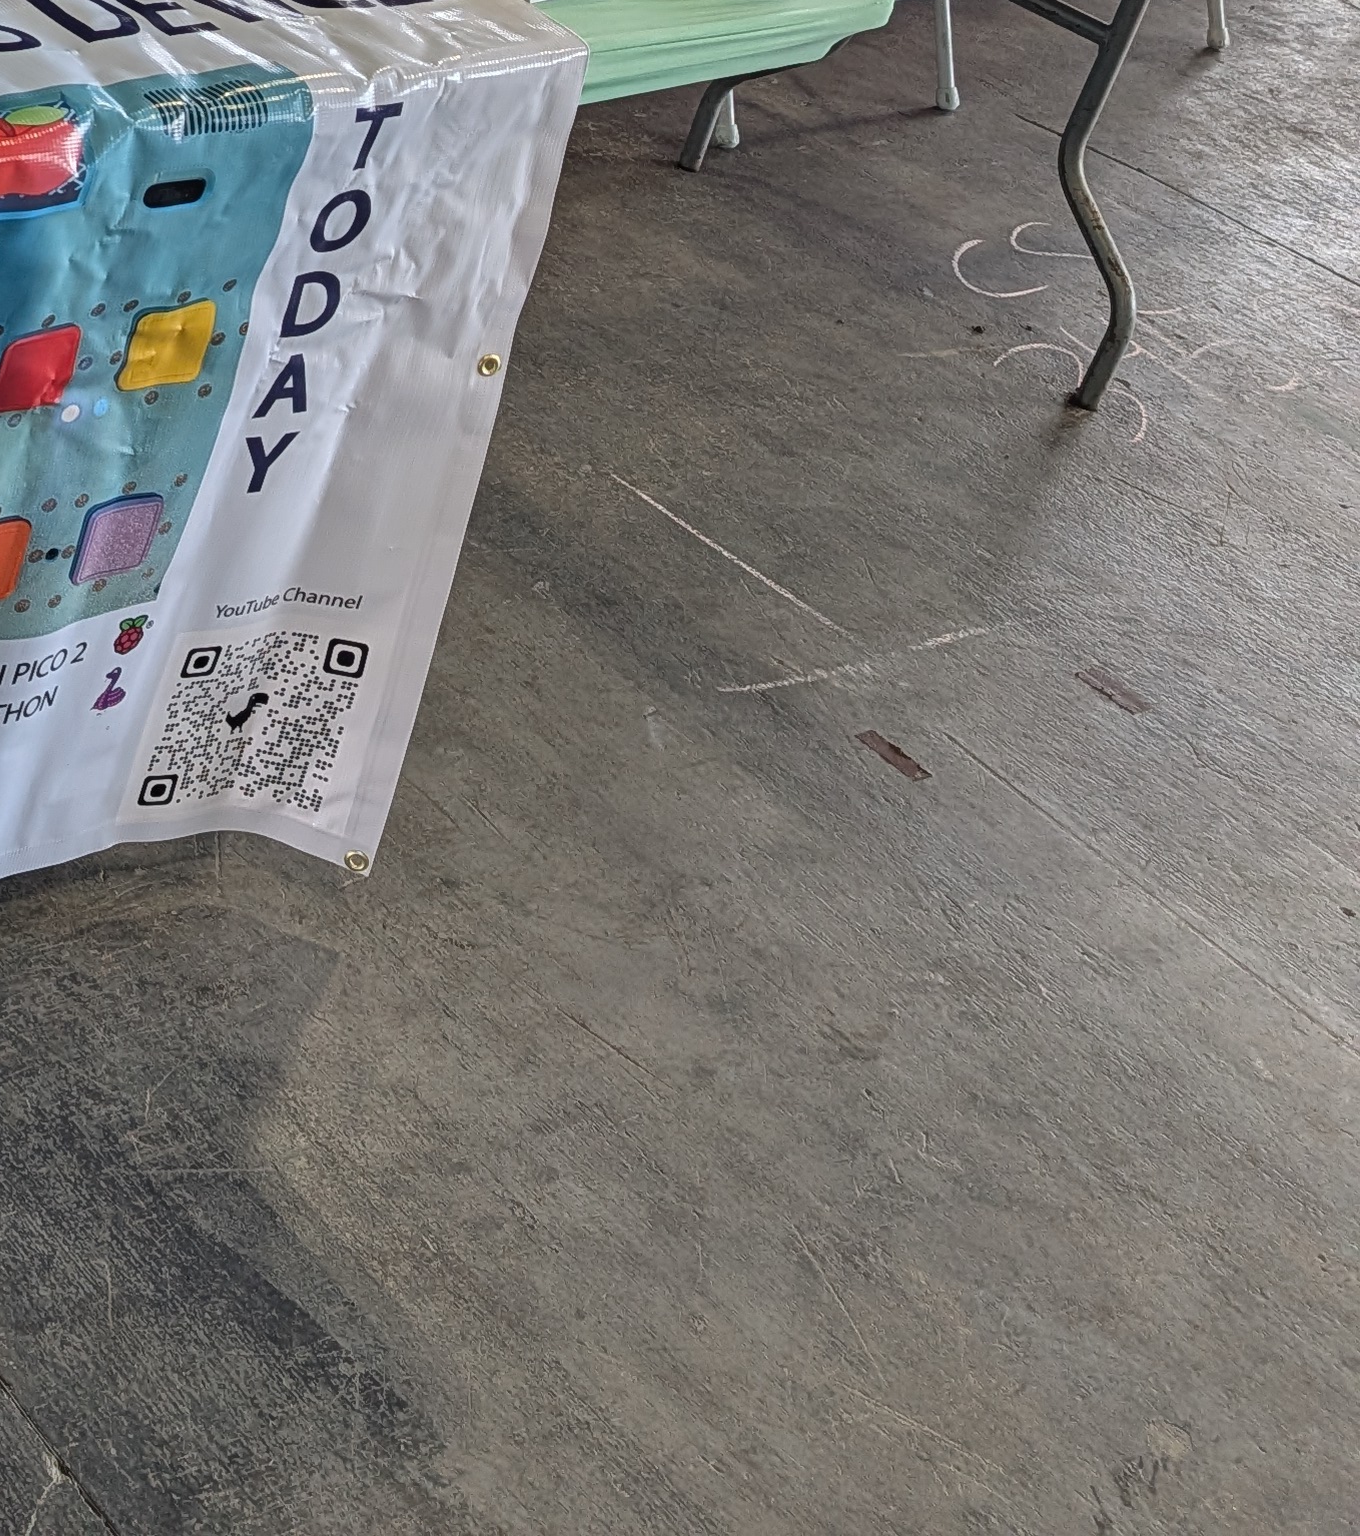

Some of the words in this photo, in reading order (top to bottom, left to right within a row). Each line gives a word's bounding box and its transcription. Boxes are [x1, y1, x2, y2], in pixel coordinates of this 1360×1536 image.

[246, 101, 405, 494] TODAY
[214, 594, 281, 620] YouTube
[282, 586, 365, 612] Channel
[10, 648, 69, 686] PICO
[69, 641, 88, 666] 2
